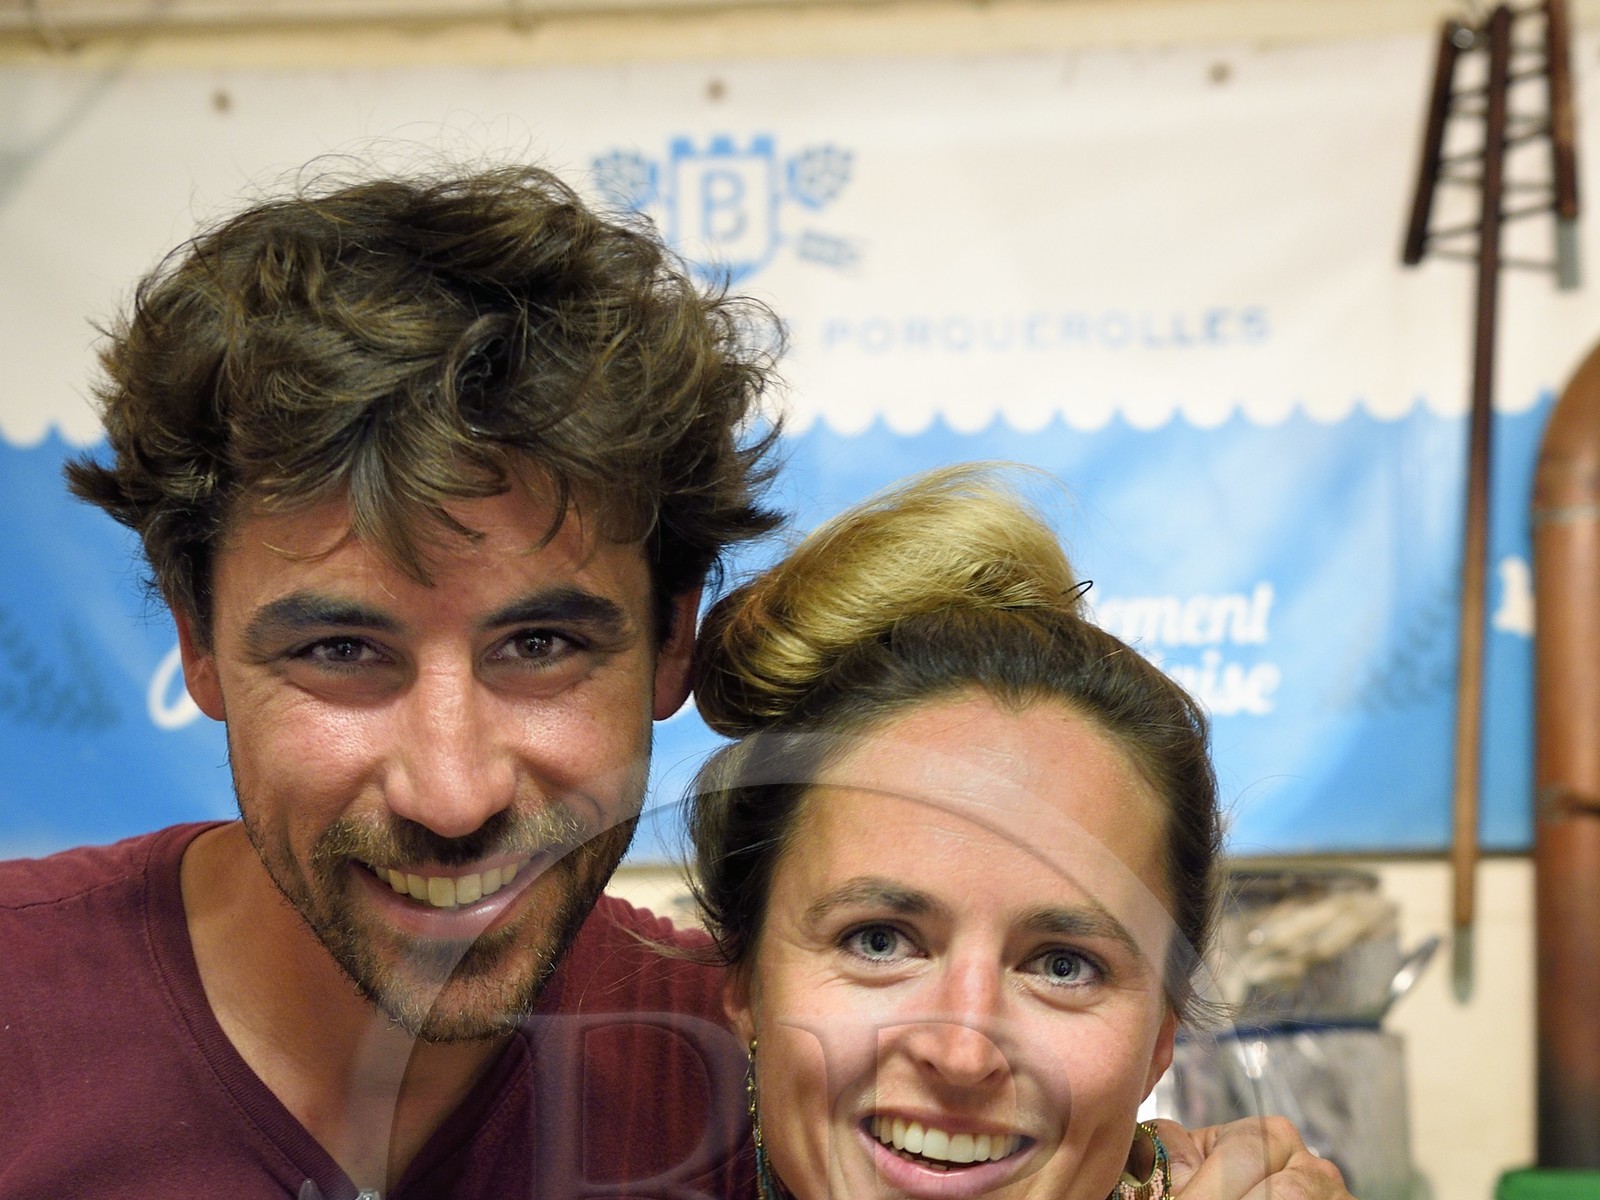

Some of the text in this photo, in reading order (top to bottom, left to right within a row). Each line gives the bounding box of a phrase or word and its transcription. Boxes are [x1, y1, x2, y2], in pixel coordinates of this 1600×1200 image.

[700, 168, 748, 243] B
[823, 307, 1272, 353] PORQUEROLLES
[1086, 579, 1275, 647] ement
